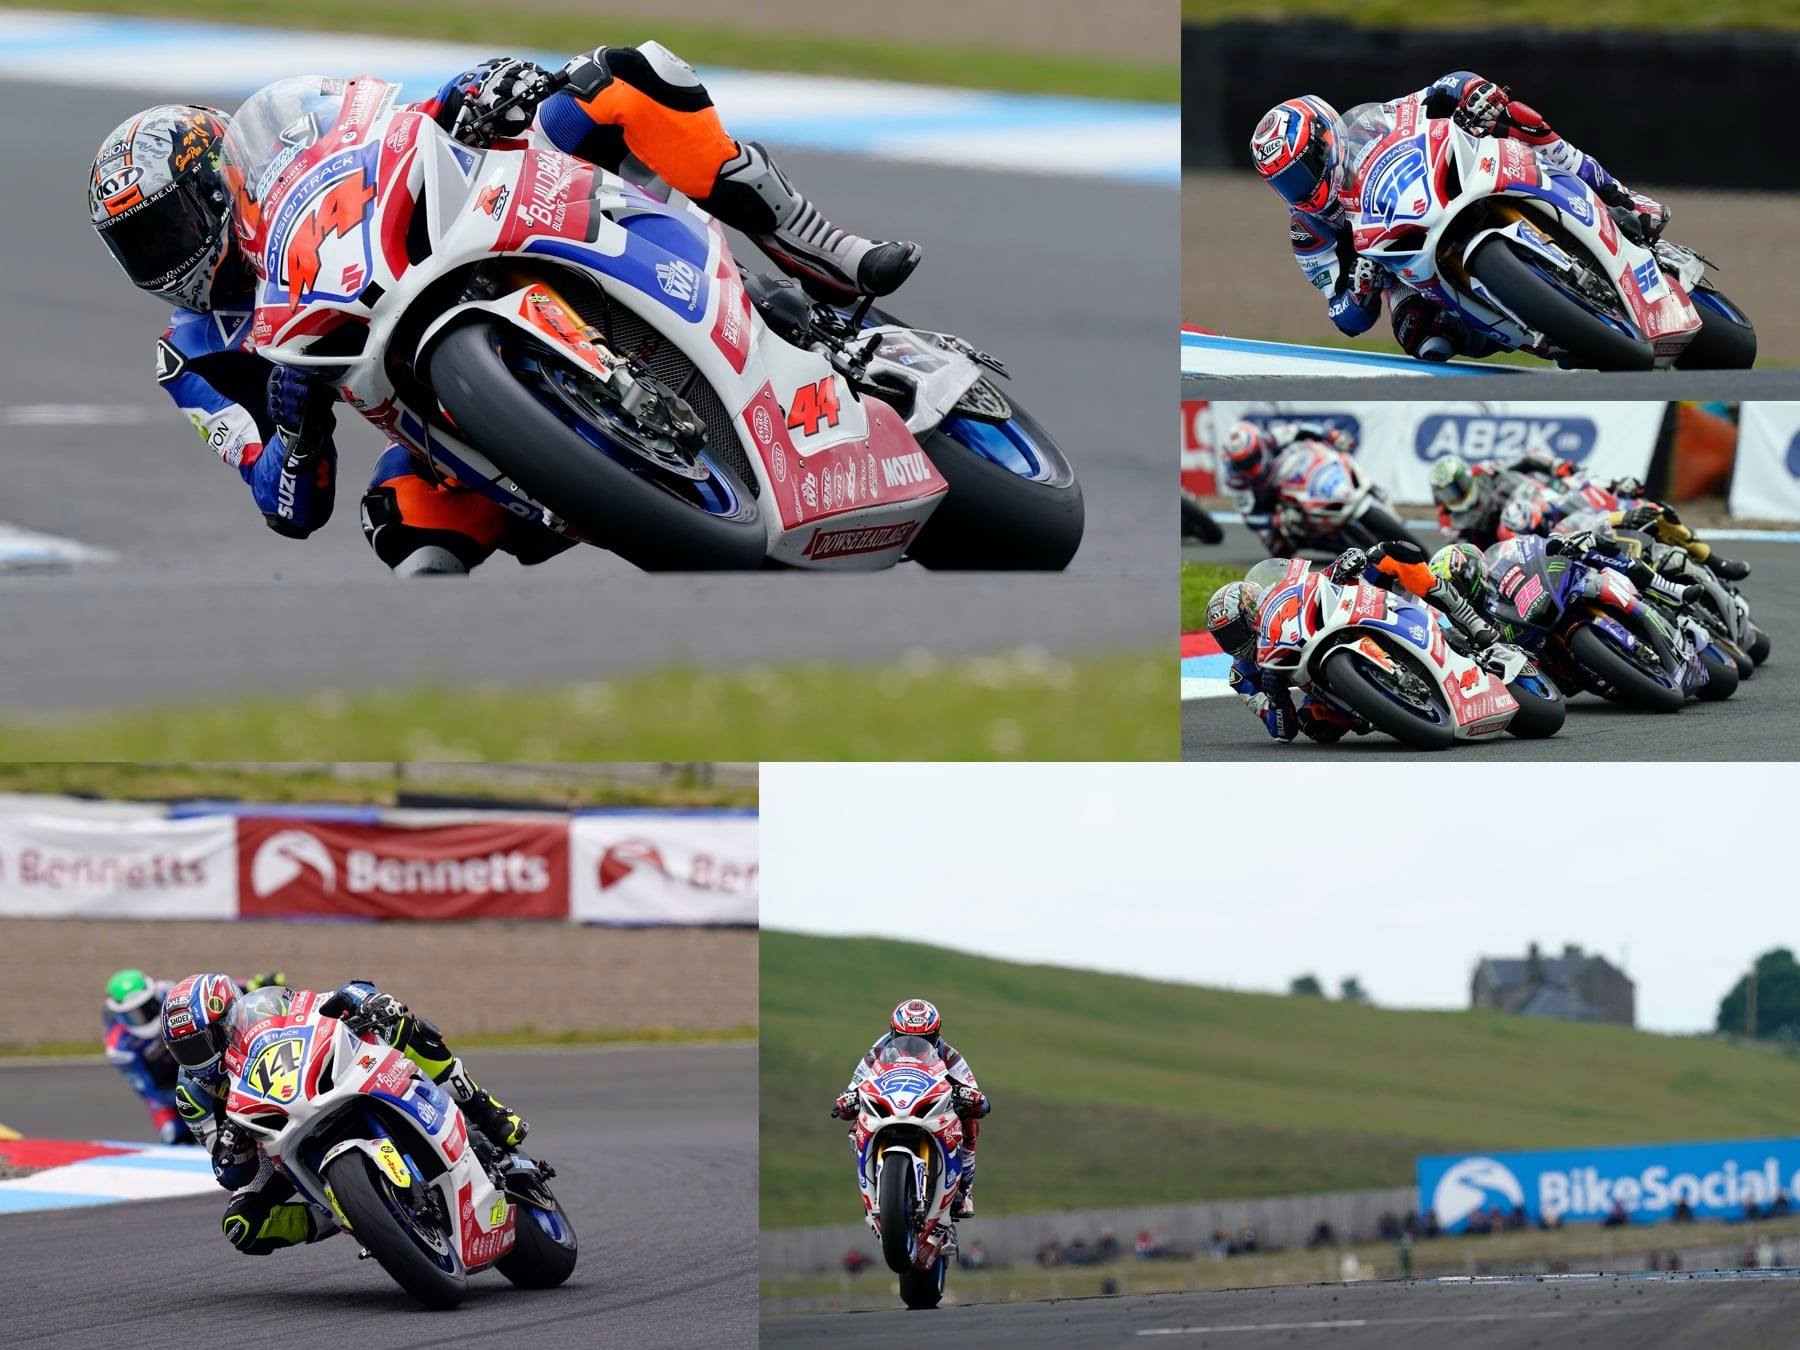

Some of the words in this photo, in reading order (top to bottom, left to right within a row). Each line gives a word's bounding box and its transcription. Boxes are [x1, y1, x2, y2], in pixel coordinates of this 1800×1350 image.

[97, 171, 132, 201] KYT
[272, 158, 308, 204] Bennetts
[1376, 149, 1428, 232] 52
[288, 167, 377, 314] 44
[1634, 257, 1660, 295] 52
[787, 374, 840, 437] 44
[1426, 421, 1563, 461] AB2K
[881, 451, 931, 488] MOTUL
[1514, 574, 1544, 618] 22
[1268, 594, 1303, 649] 44
[1459, 667, 1480, 691] 44
[18, 847, 208, 890] Bennetts
[346, 846, 549, 894] Bennetts
[170, 1015, 191, 1027] SHOEI
[243, 1020, 271, 1044] PIRELLI
[255, 1041, 300, 1098] 14
[881, 1078, 929, 1097] 52
